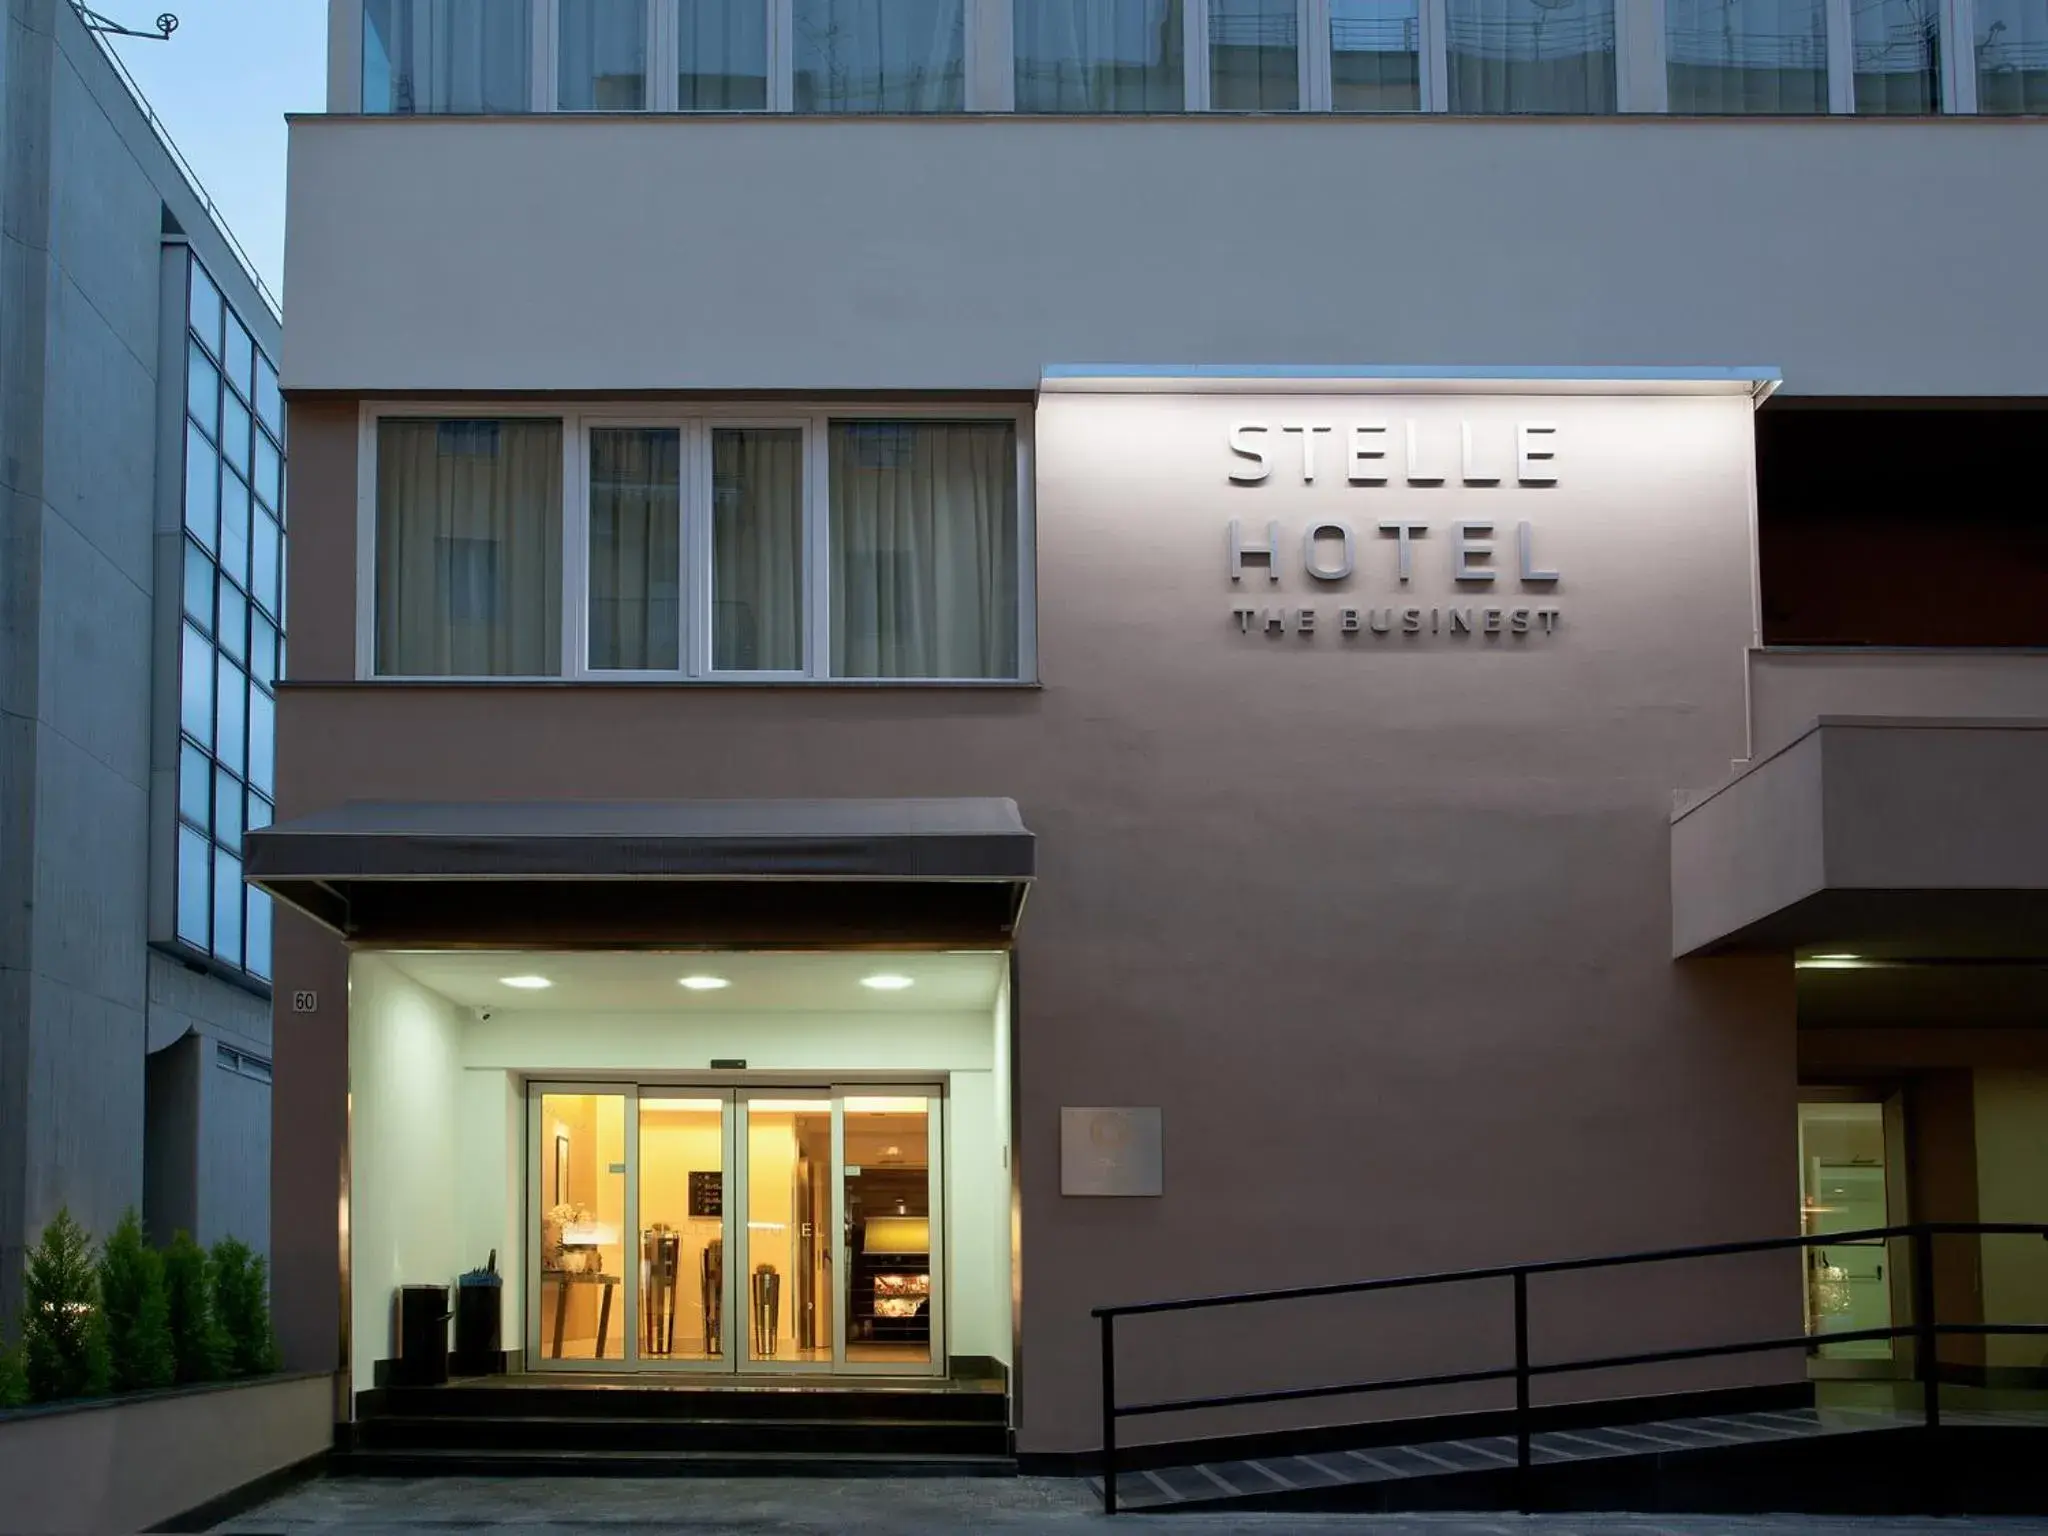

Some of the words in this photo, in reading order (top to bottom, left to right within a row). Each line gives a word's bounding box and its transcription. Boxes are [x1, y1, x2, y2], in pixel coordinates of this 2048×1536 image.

[1228, 420, 1558, 484] STELLE
[1229, 520, 1560, 582] HOTEL
[1233, 608, 1316, 634] THE
[1341, 608, 1560, 634] BUSINEST
[296, 993, 314, 1010] 60
